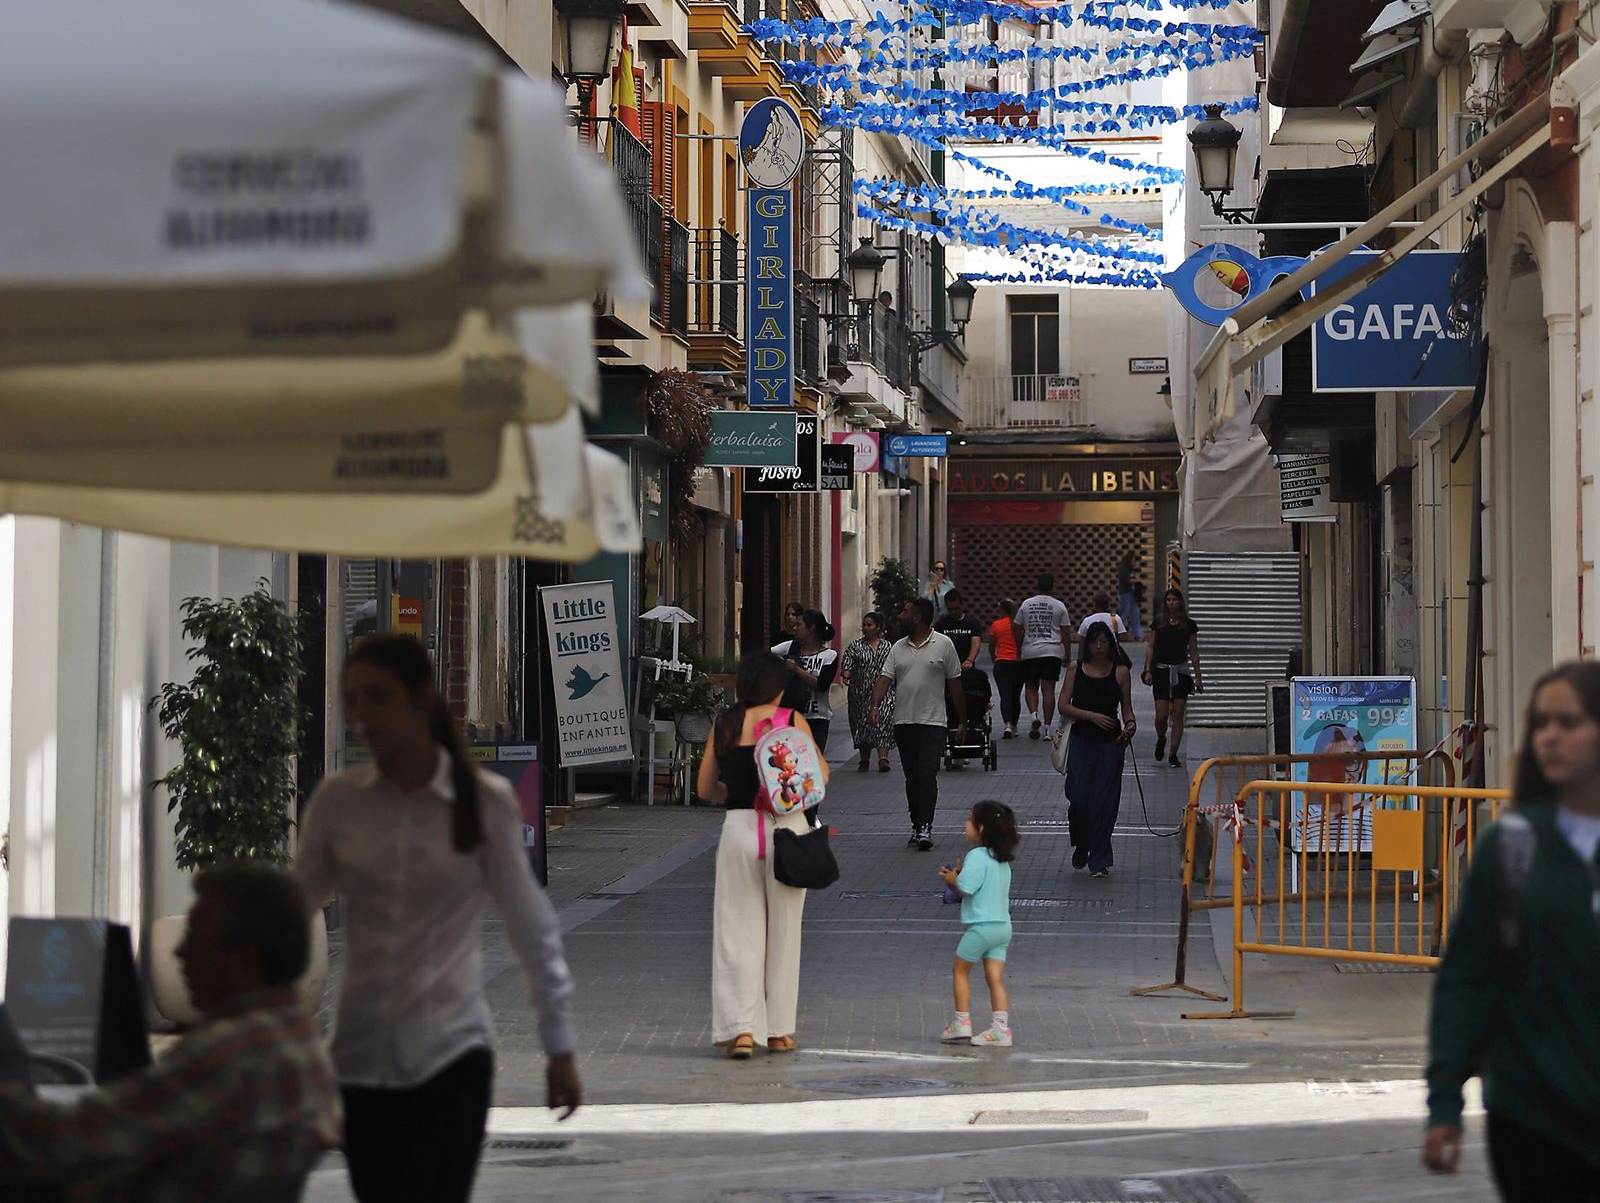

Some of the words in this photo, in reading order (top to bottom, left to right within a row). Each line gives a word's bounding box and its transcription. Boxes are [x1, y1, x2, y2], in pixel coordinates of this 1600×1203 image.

[755, 194, 787, 401] GIRLADY
[796, 422, 814, 435] OS
[705, 429, 784, 447] ierbaluisa
[853, 442, 873, 455] ala
[1281, 457, 1329, 469] MANUALIDADES
[758, 466, 802, 482] JUSTO
[950, 472, 1026, 492] ADOS
[1042, 472, 1076, 492] LA
[1091, 470, 1174, 492] IBENS
[1282, 480, 1306, 489] BELLAS
[1306, 477, 1327, 486] ARTES
[398, 606, 418, 615] undo
[552, 597, 606, 620] Little
[556, 631, 611, 652] kings
[799, 656, 822, 671] EAM
[1307, 684, 1338, 695] vision
[559, 708, 626, 727] BOUTIQUE
[1302, 709, 1312, 721] 2
[1316, 709, 1358, 721] GAFAS
[1367, 707, 1409, 727] 99€
[562, 725, 626, 742] INFANTIL
[1381, 742, 1404, 750] ADULTO
